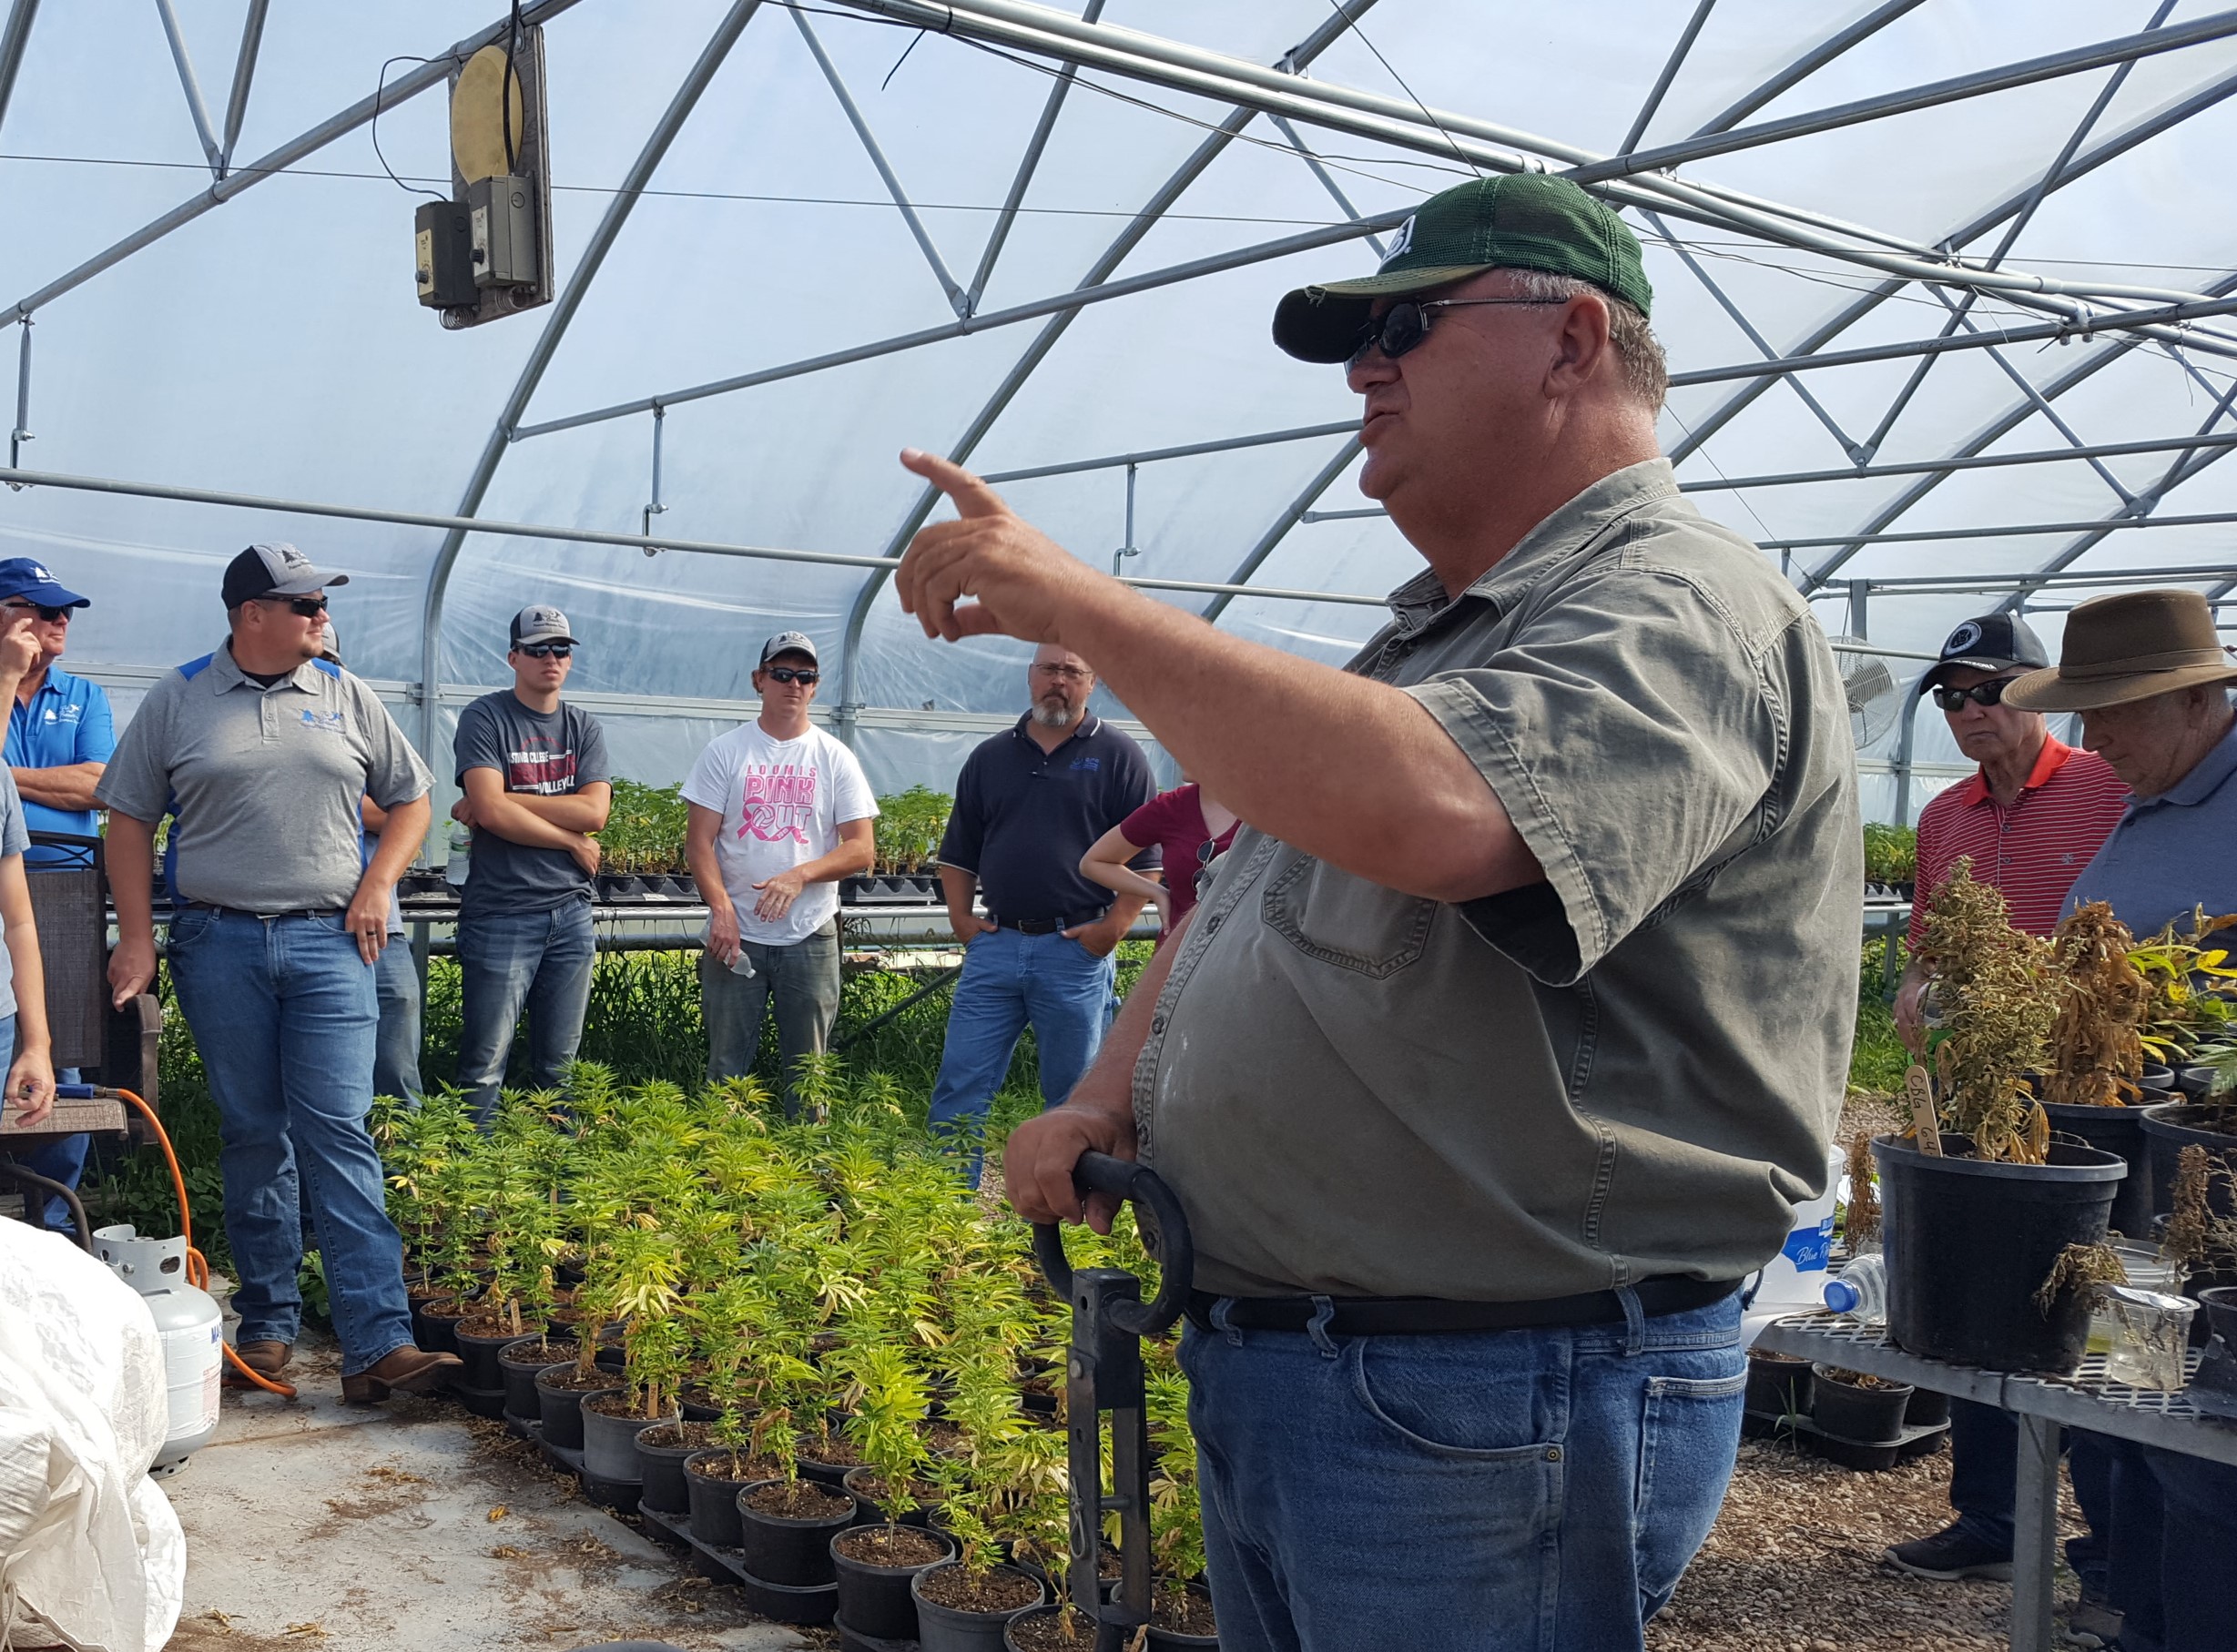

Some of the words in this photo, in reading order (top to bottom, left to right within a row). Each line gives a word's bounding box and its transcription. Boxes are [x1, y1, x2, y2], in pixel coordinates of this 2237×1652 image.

[747, 765, 817, 777] LOOMIS
[743, 775, 816, 805] PINK
[1911, 1075, 1927, 1109] CBG
[1795, 1246, 1819, 1265] Blue
